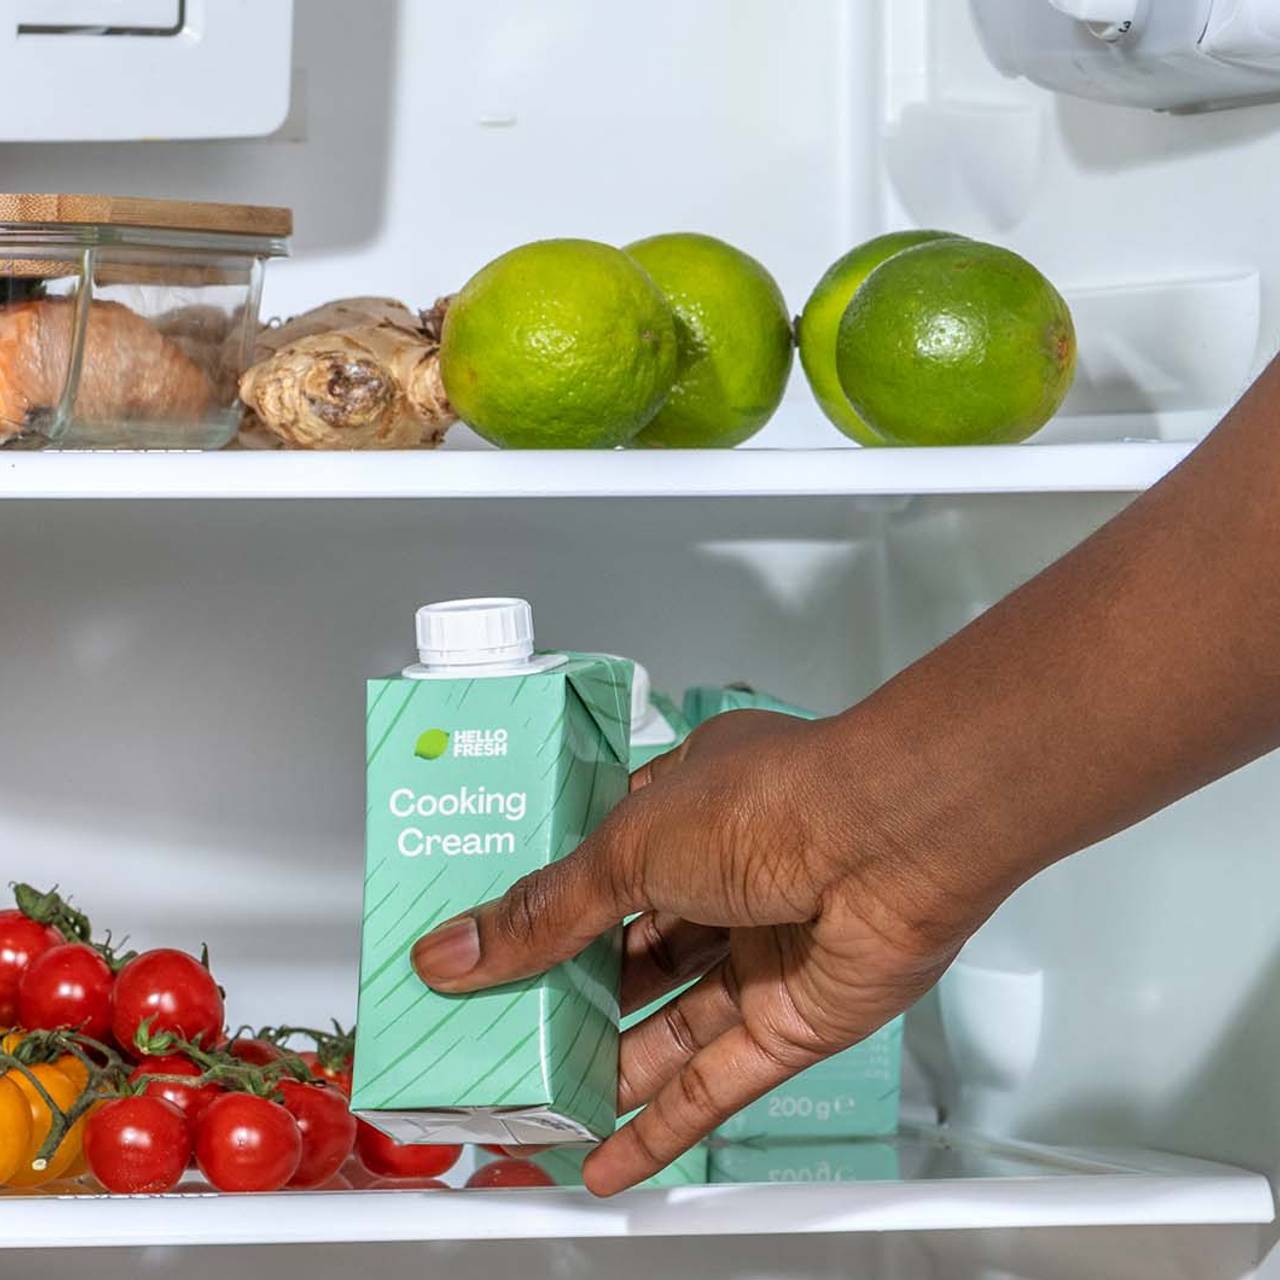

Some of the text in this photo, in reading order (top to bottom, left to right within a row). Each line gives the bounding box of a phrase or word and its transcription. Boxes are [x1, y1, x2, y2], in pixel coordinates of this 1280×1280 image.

[453, 729, 508, 744] HELLO
[453, 742, 508, 758] FRESH
[389, 786, 527, 821] Cooking
[397, 827, 516, 858] Cream
